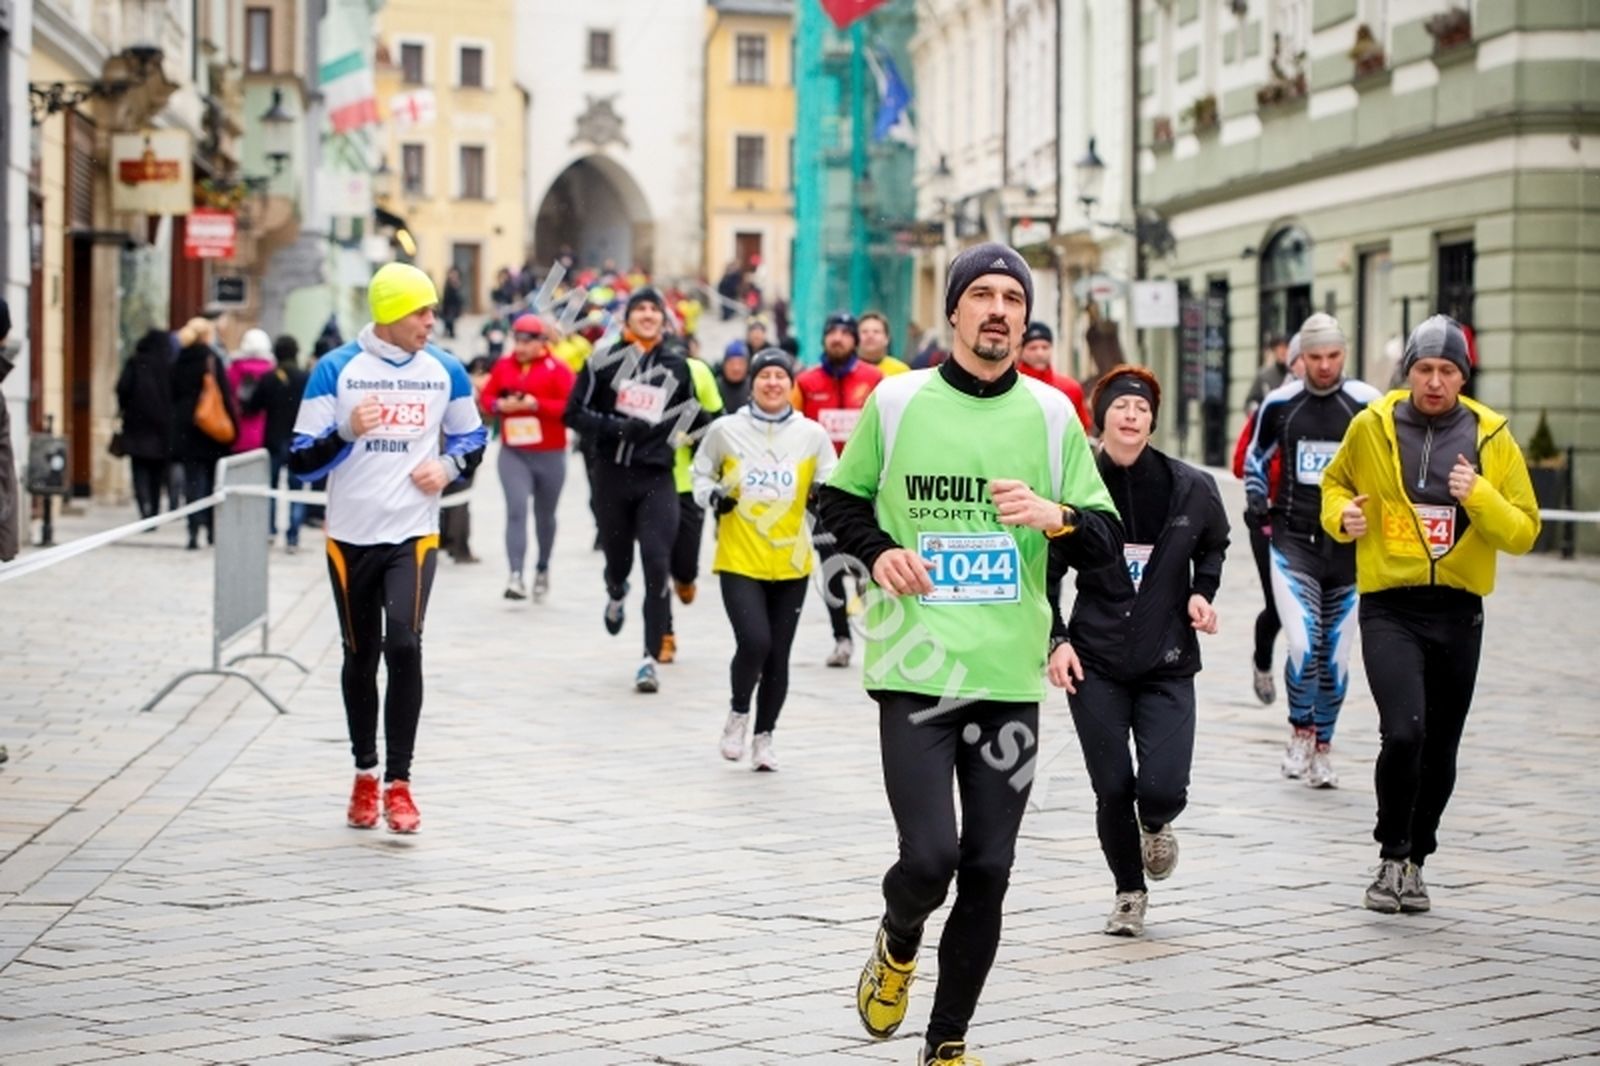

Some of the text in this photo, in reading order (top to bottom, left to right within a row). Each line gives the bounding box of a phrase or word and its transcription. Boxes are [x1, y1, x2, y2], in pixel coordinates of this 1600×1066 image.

[346, 378, 394, 391] Schnelle
[380, 404, 424, 425] 786
[1302, 453, 1333, 470] 87
[746, 470, 793, 487] 5210
[909, 507, 977, 521] SPORT
[928, 552, 1013, 582] 1044
